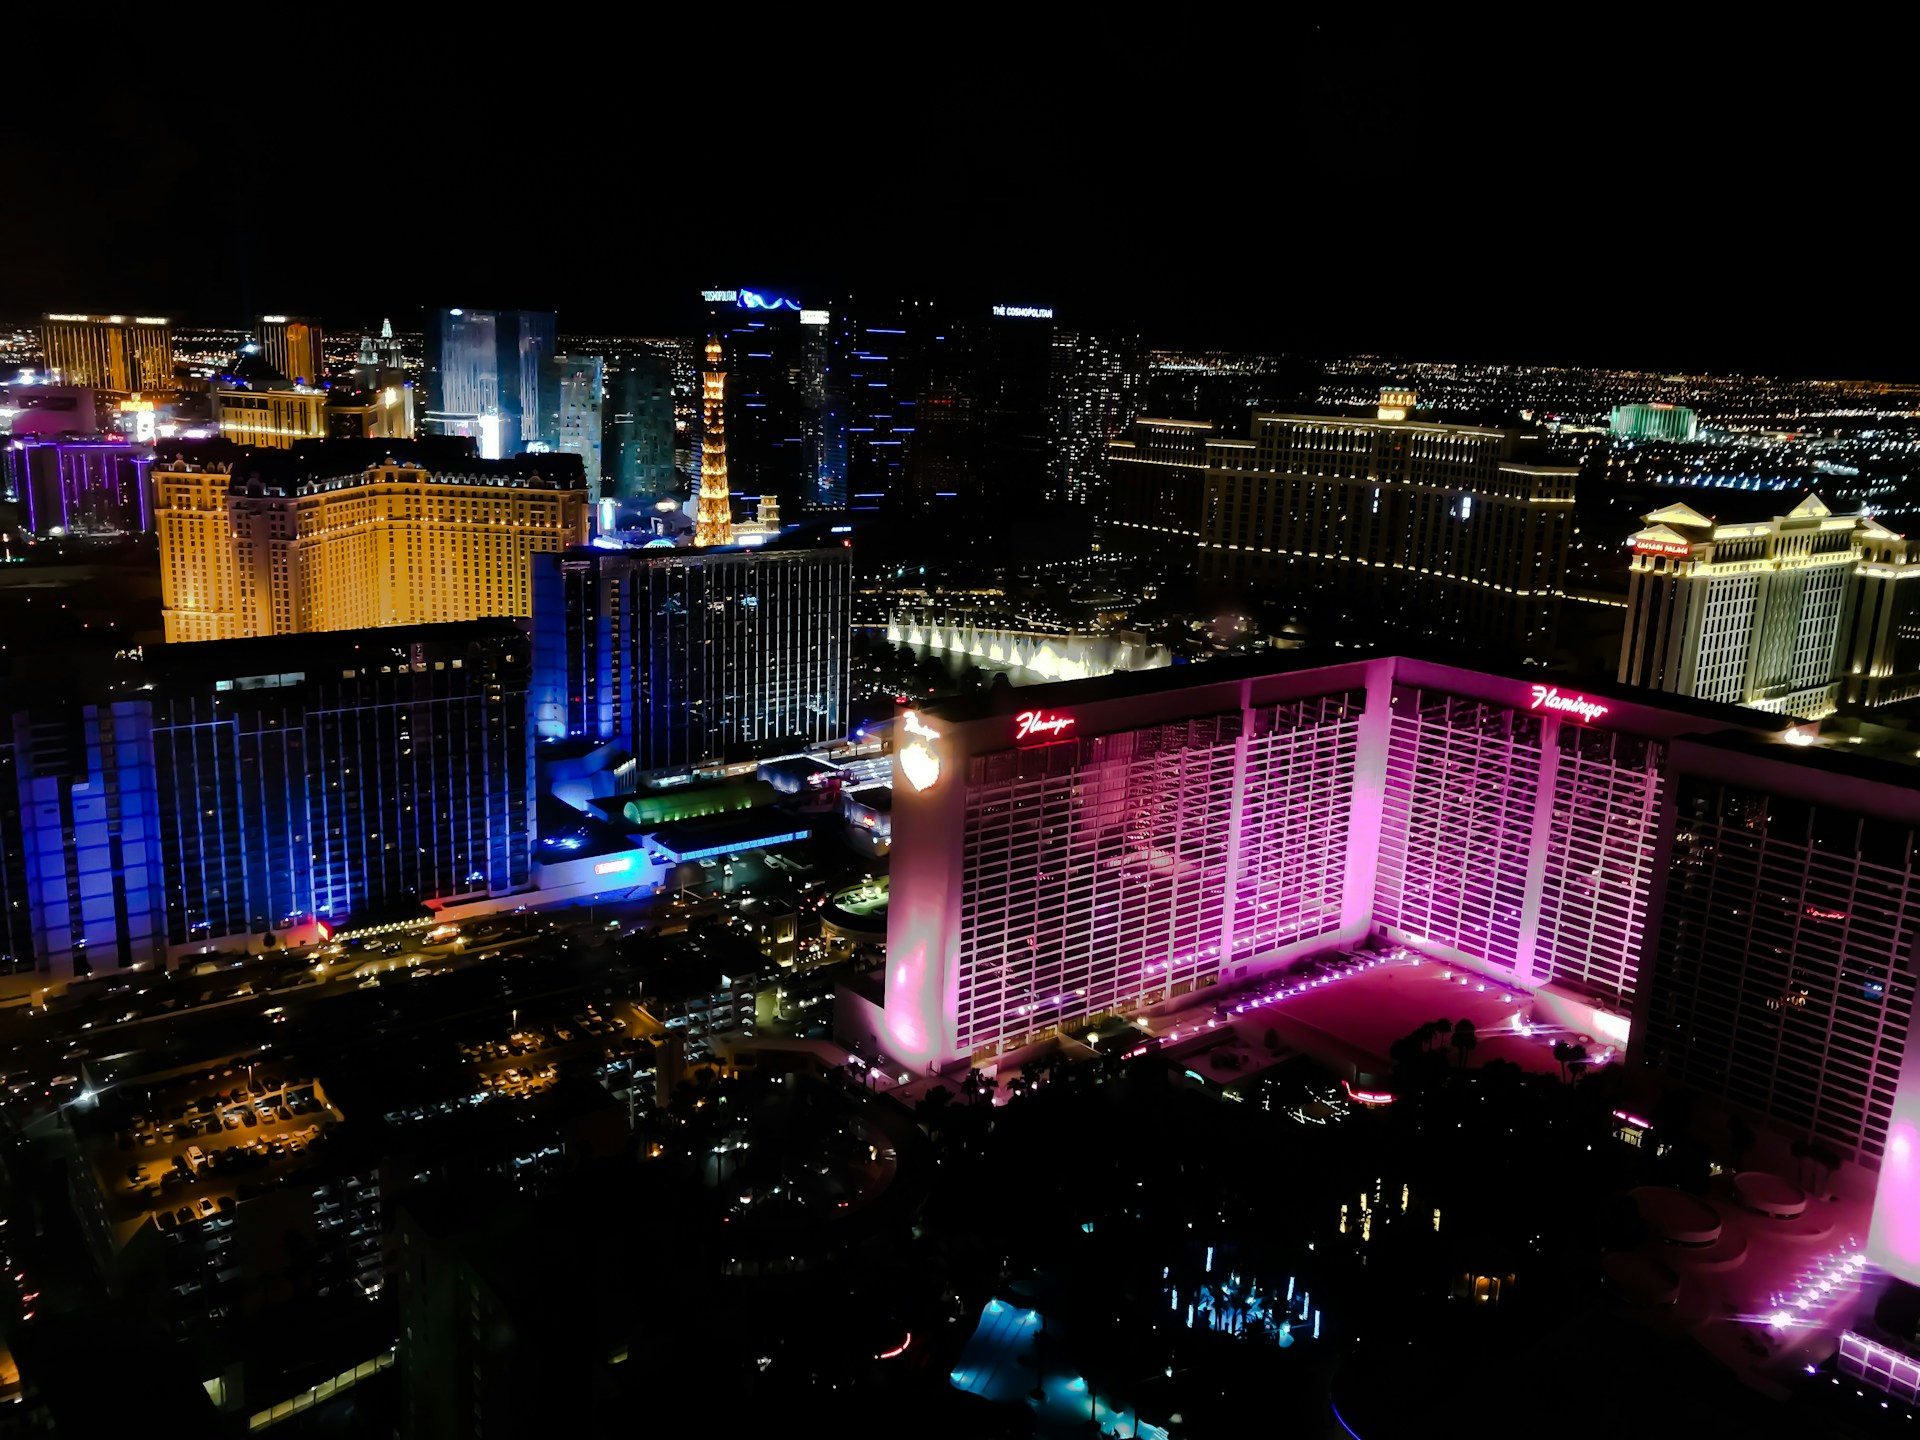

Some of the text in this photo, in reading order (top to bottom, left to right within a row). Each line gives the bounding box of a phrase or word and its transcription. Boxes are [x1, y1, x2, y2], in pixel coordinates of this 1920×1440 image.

[992, 305, 1053, 319] THE COSMOPOLITAN
[1531, 685, 1609, 723] Flamingo
